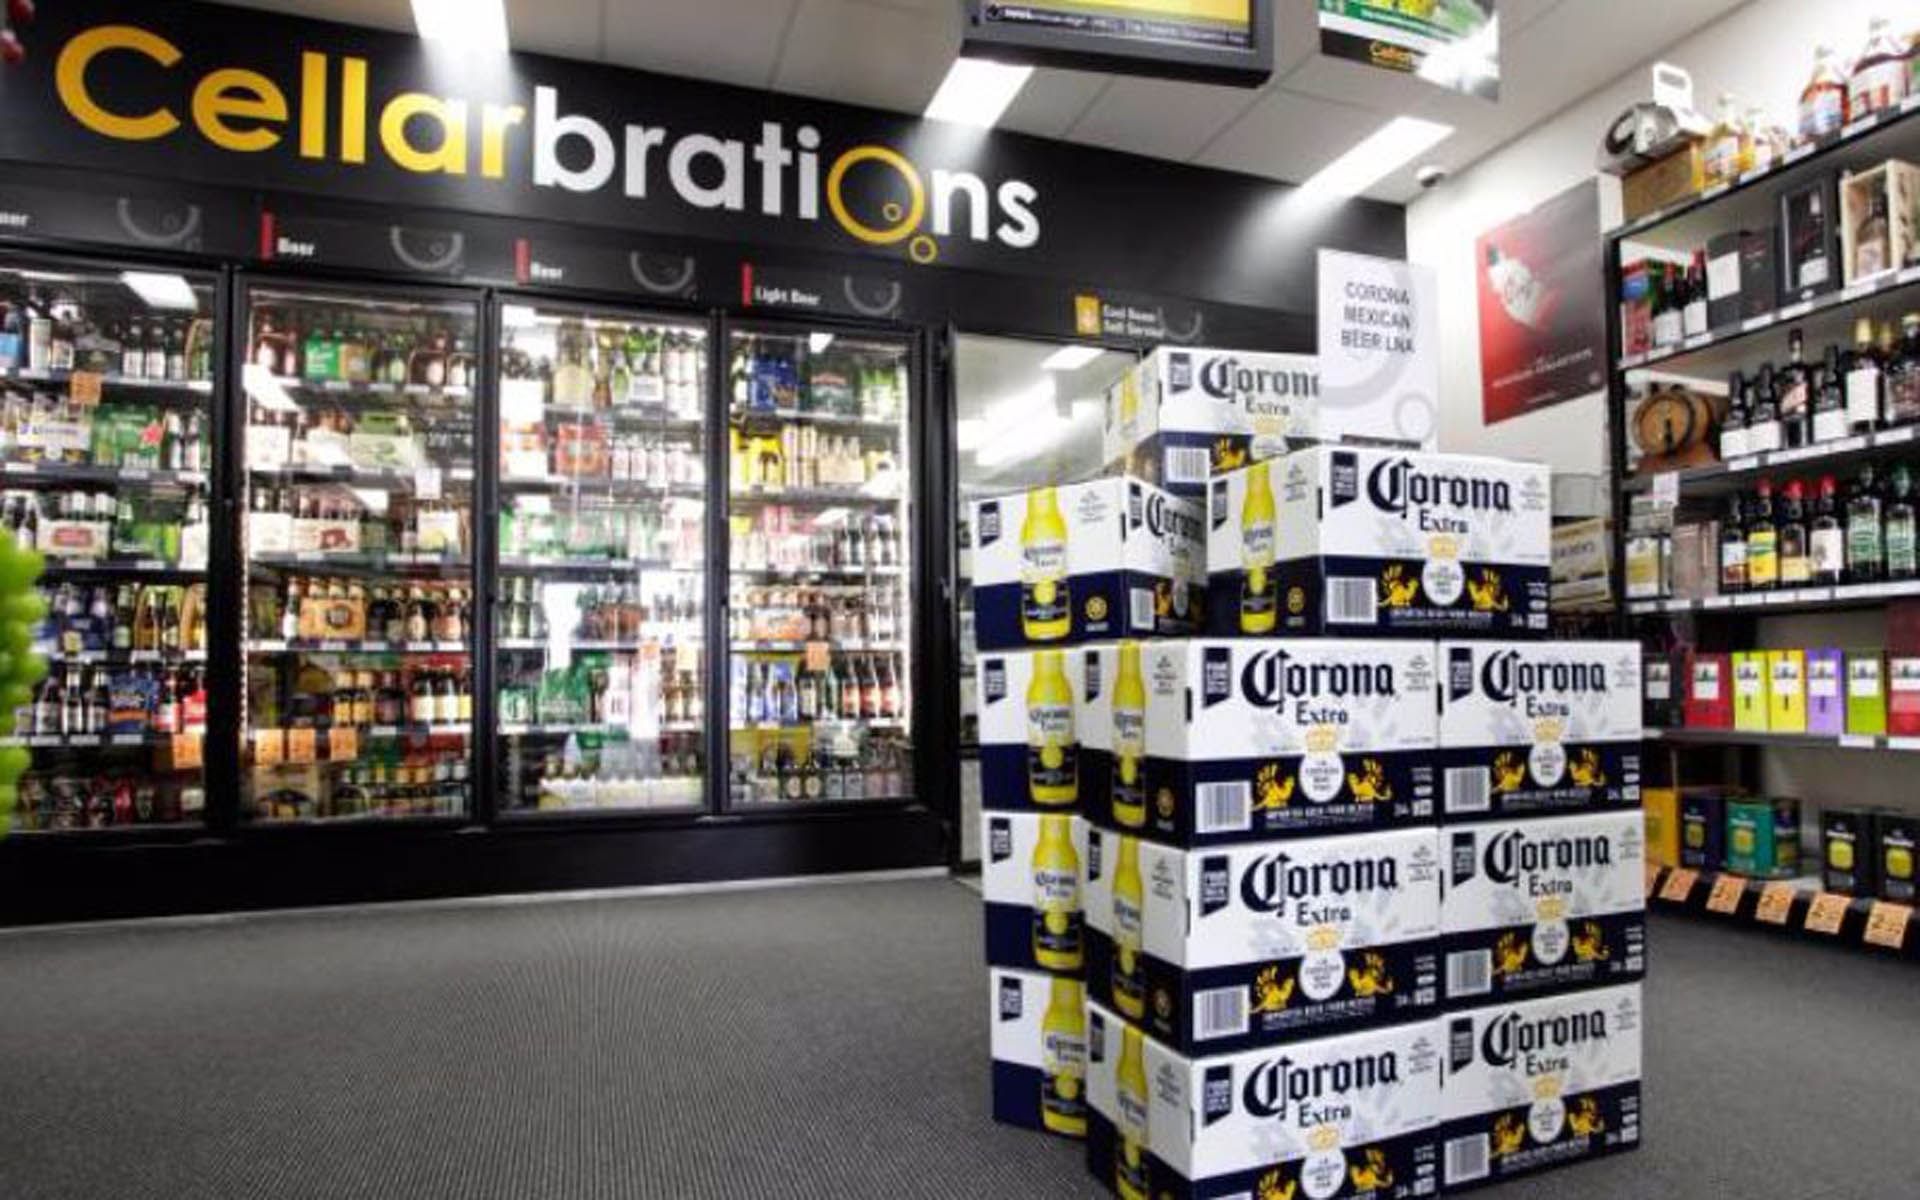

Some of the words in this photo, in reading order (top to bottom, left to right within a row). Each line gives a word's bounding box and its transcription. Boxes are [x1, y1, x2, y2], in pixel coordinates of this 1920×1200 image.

[1345, 282, 1410, 305] CORONA
[1344, 305, 1411, 330] MEXICAN
[1341, 329, 1381, 350] BEER
[1366, 458, 1512, 519] Corona
[1419, 509, 1469, 533] Extra
[1240, 649, 1396, 714] Corona
[1481, 650, 1607, 707] Corona
[1296, 701, 1348, 725] Extra
[1526, 696, 1570, 717] Extra
[1484, 829, 1611, 887] Corona
[1240, 853, 1398, 917] Corona
[1529, 876, 1573, 897] Extra
[1297, 902, 1352, 926] Extra
[1482, 1010, 1607, 1069] Corona
[1243, 1055, 1398, 1121] Corona
[1299, 1104, 1352, 1127] Extra
